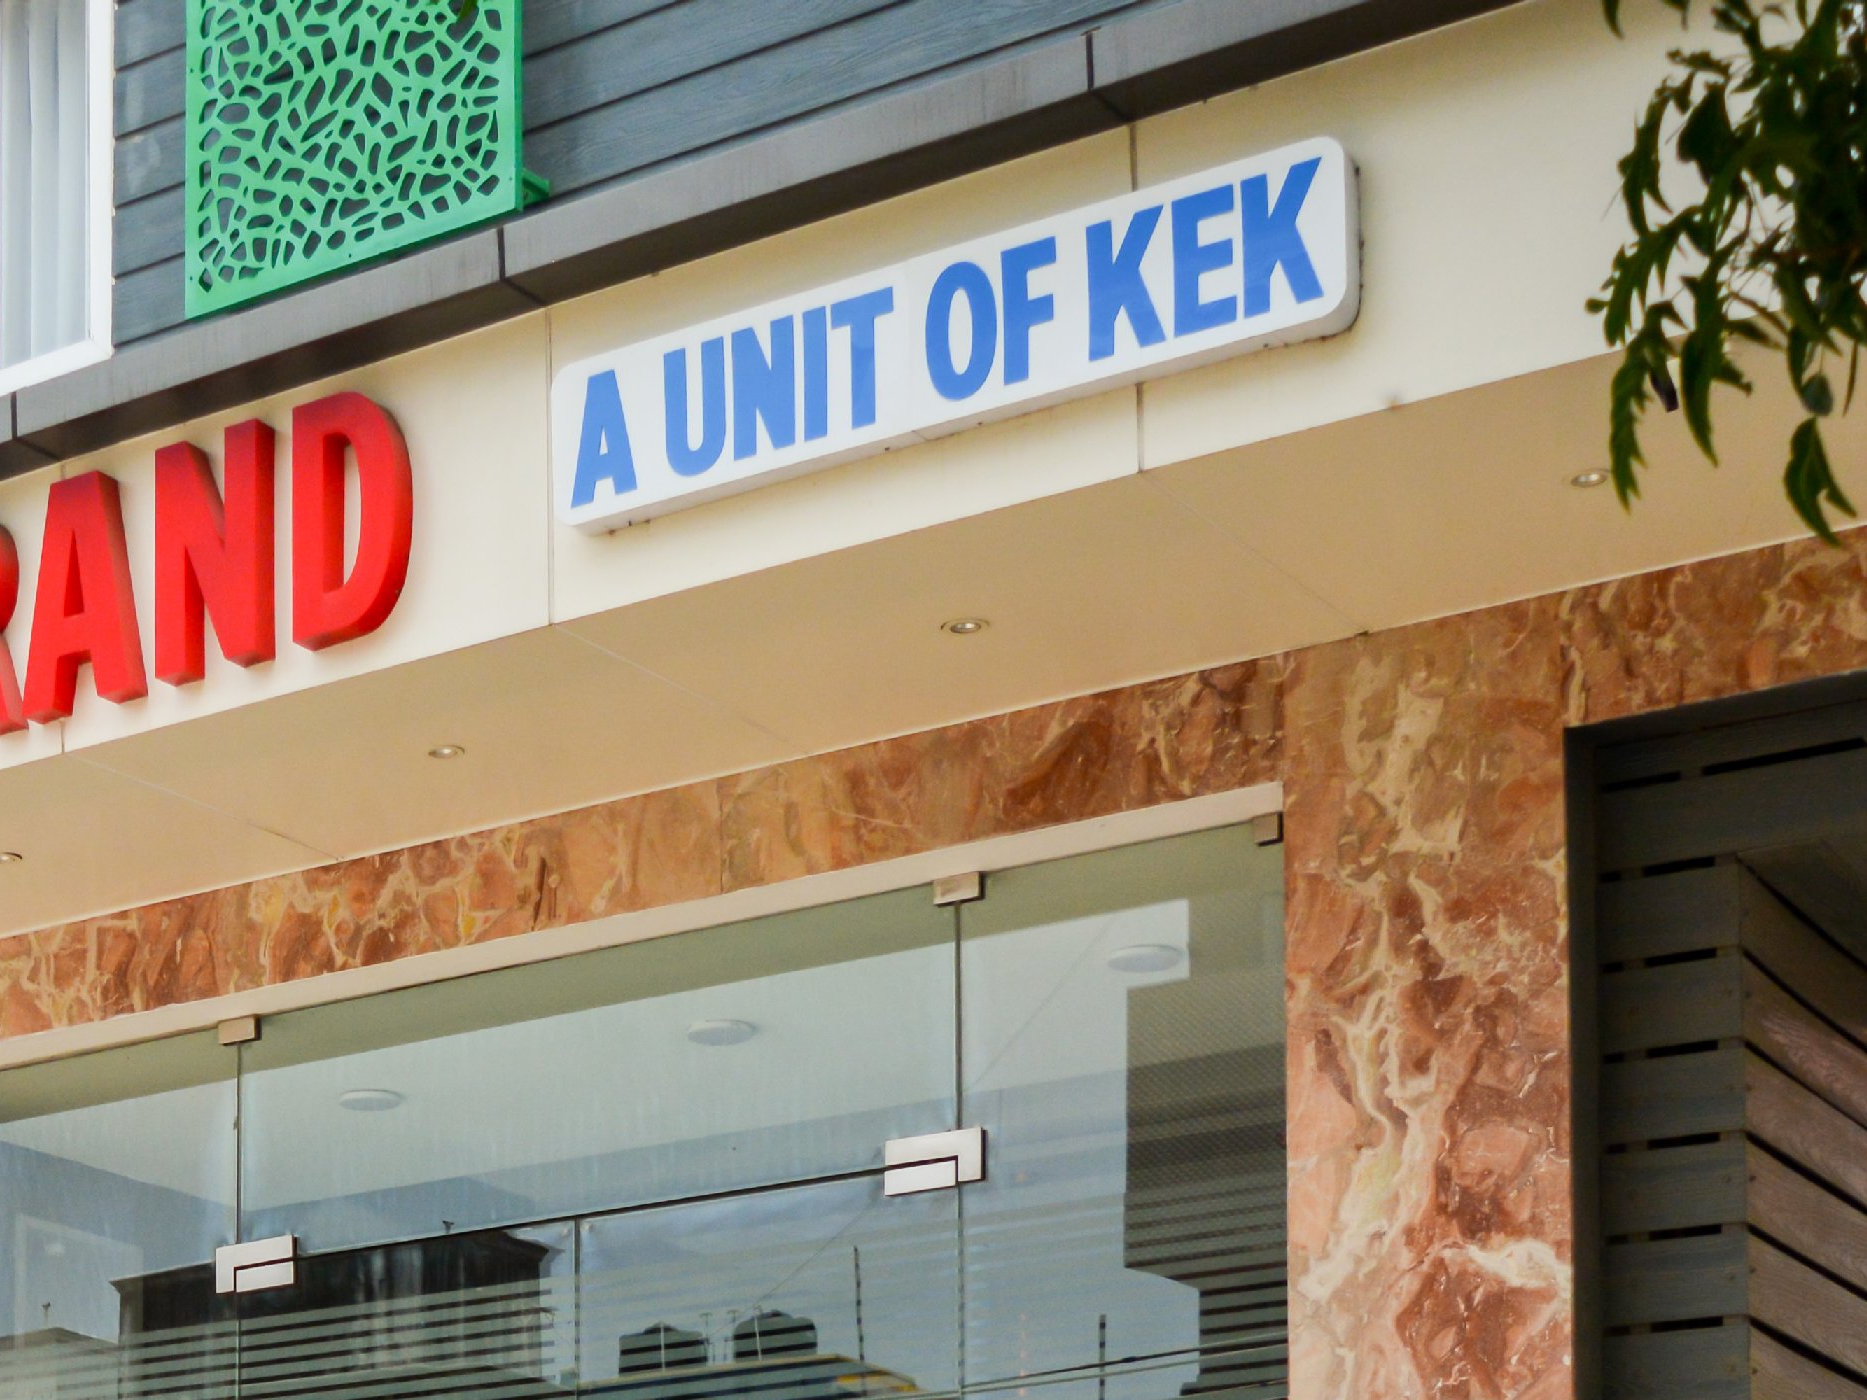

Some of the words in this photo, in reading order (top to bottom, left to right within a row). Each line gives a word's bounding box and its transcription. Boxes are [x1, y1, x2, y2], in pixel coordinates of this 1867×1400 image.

[570, 369, 638, 508] A
[663, 286, 894, 477] UNIT
[924, 236, 1057, 400] OF
[1085, 156, 1323, 361] KEK
